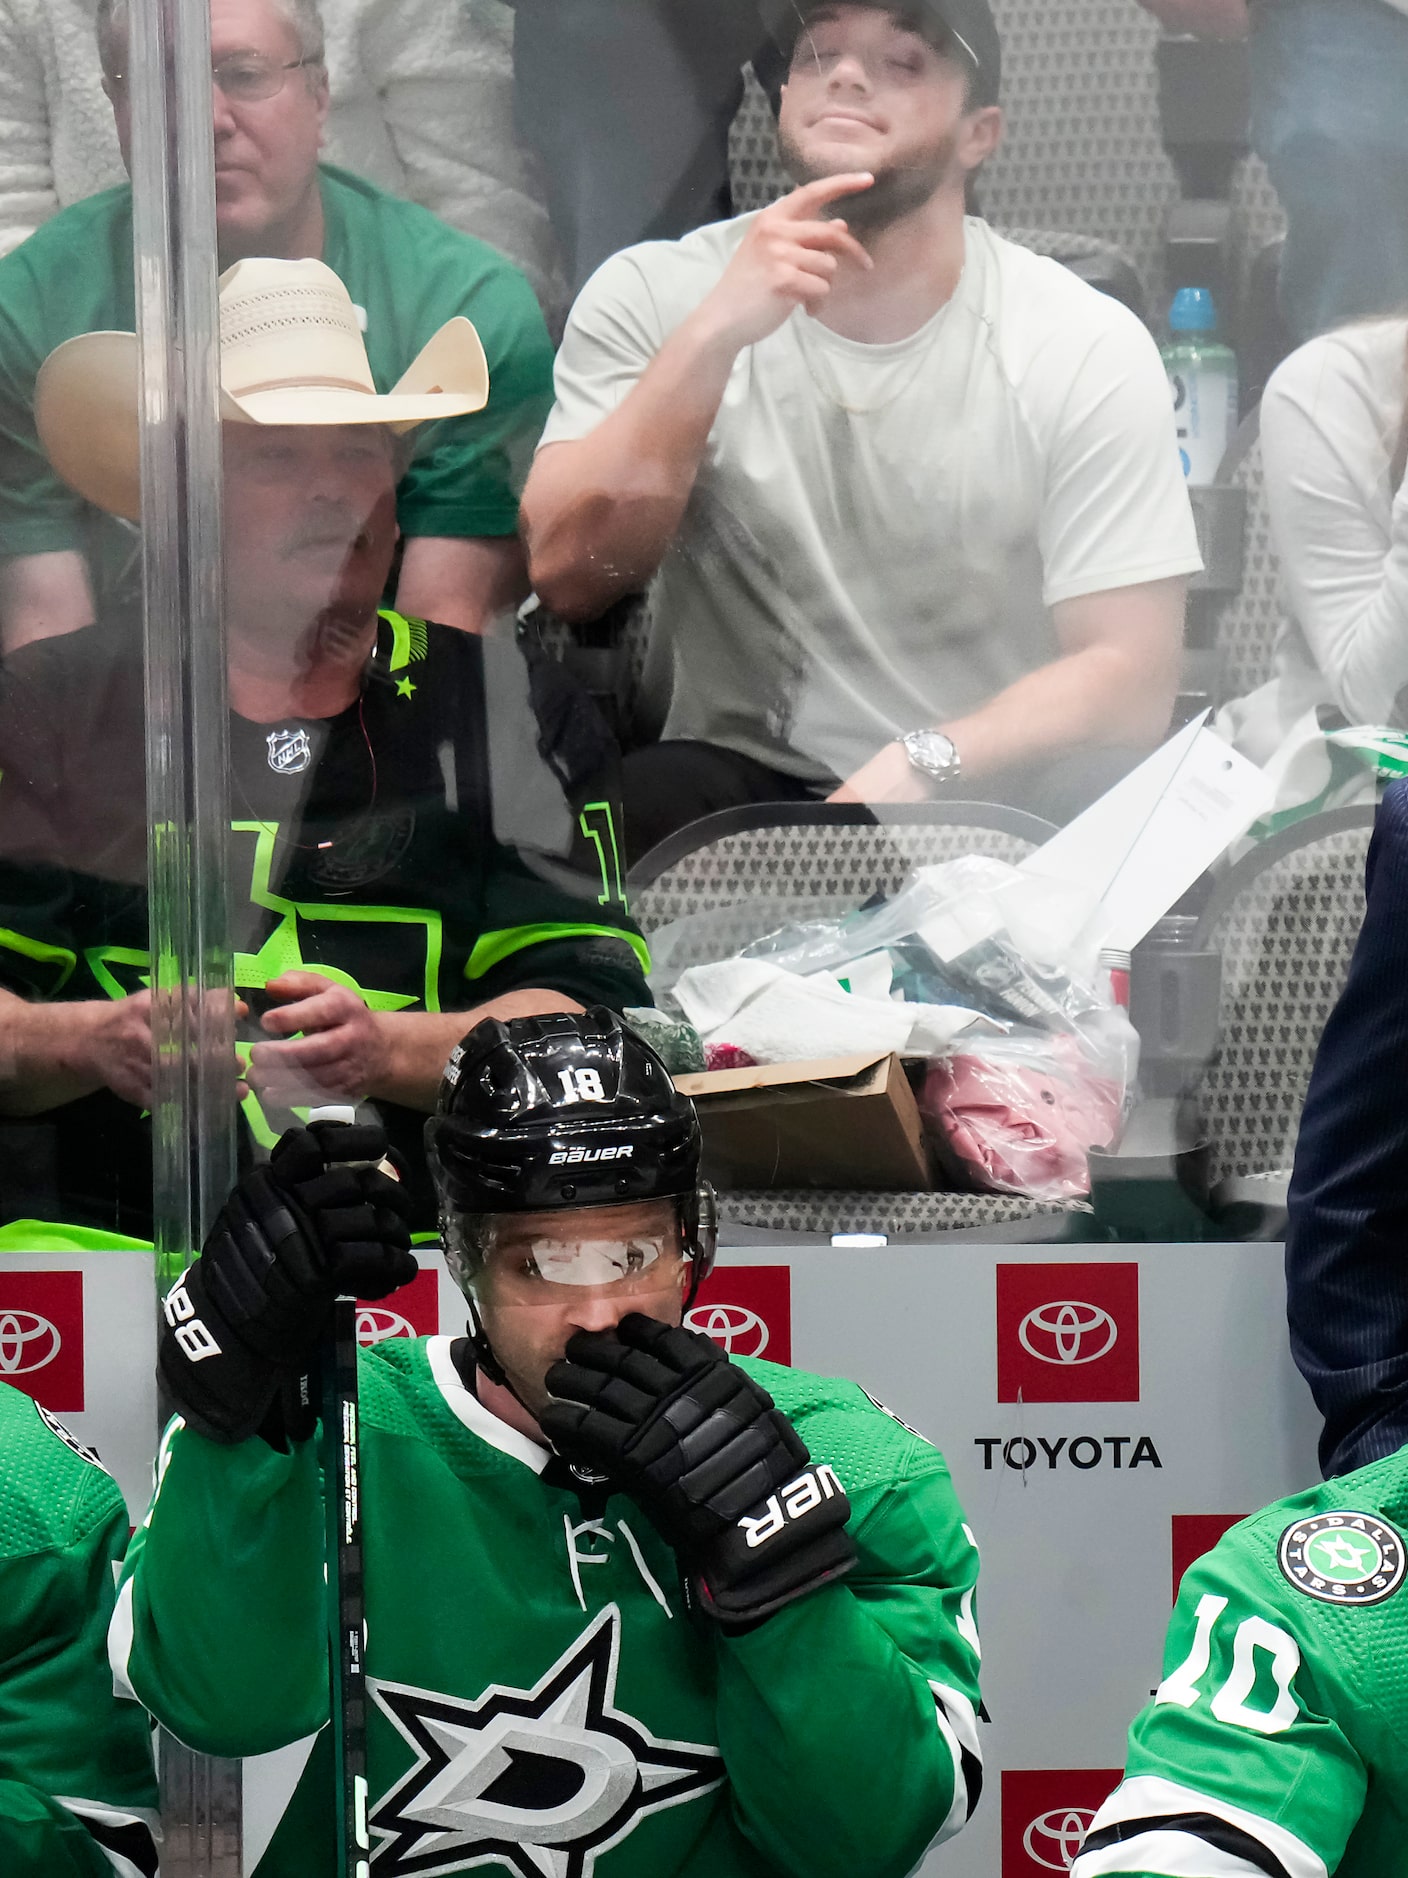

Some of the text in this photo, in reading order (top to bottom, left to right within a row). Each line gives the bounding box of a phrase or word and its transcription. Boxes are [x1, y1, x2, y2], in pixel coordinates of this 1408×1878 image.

[558, 1067, 606, 1103] 18
[974, 1436, 1163, 1470] TOYOTA
[1288, 1530, 1347, 1596] STARS
[1326, 1517, 1396, 1589] DALLAS
[1154, 1594, 1301, 1735] 10
